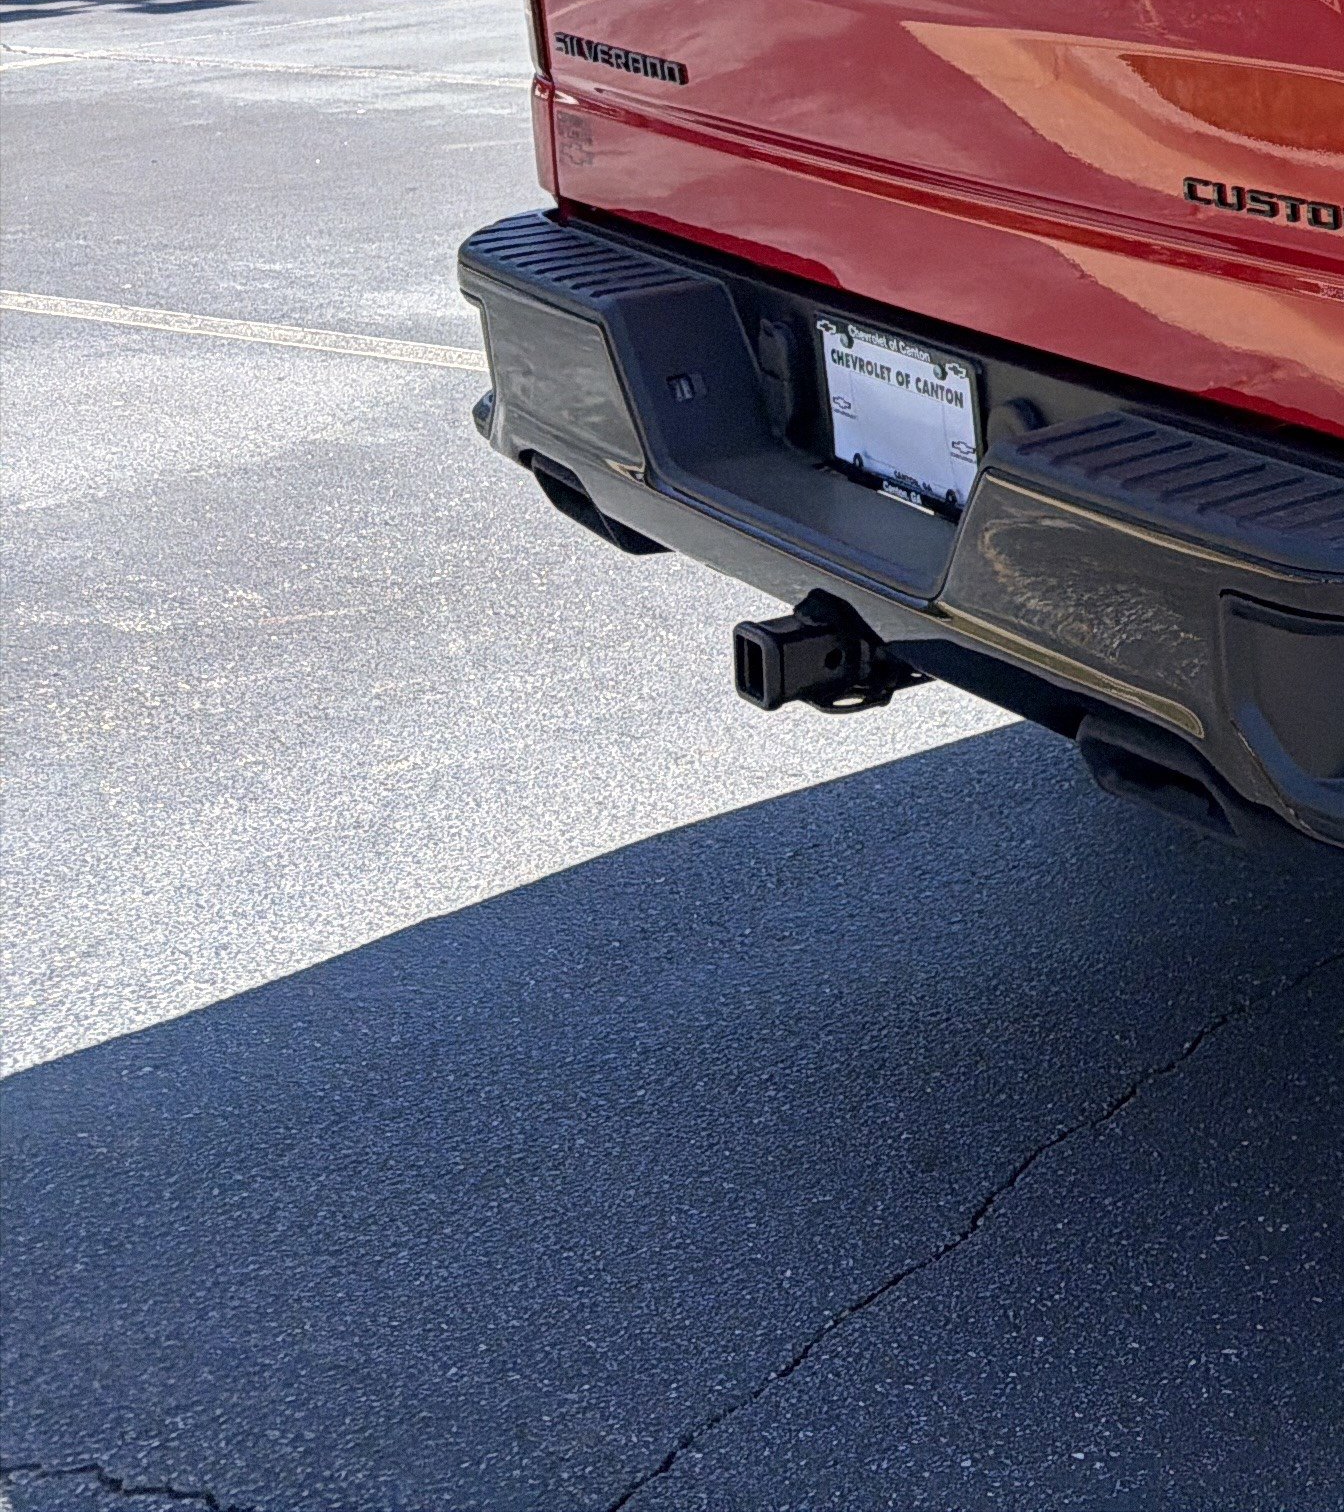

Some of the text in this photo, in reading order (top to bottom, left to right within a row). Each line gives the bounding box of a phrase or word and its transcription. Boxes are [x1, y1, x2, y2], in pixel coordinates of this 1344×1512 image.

[554, 31, 690, 86] SILVERADO
[831, 348, 964, 408] CHEVROLET OF CANTON
[898, 340, 931, 363] Canton
